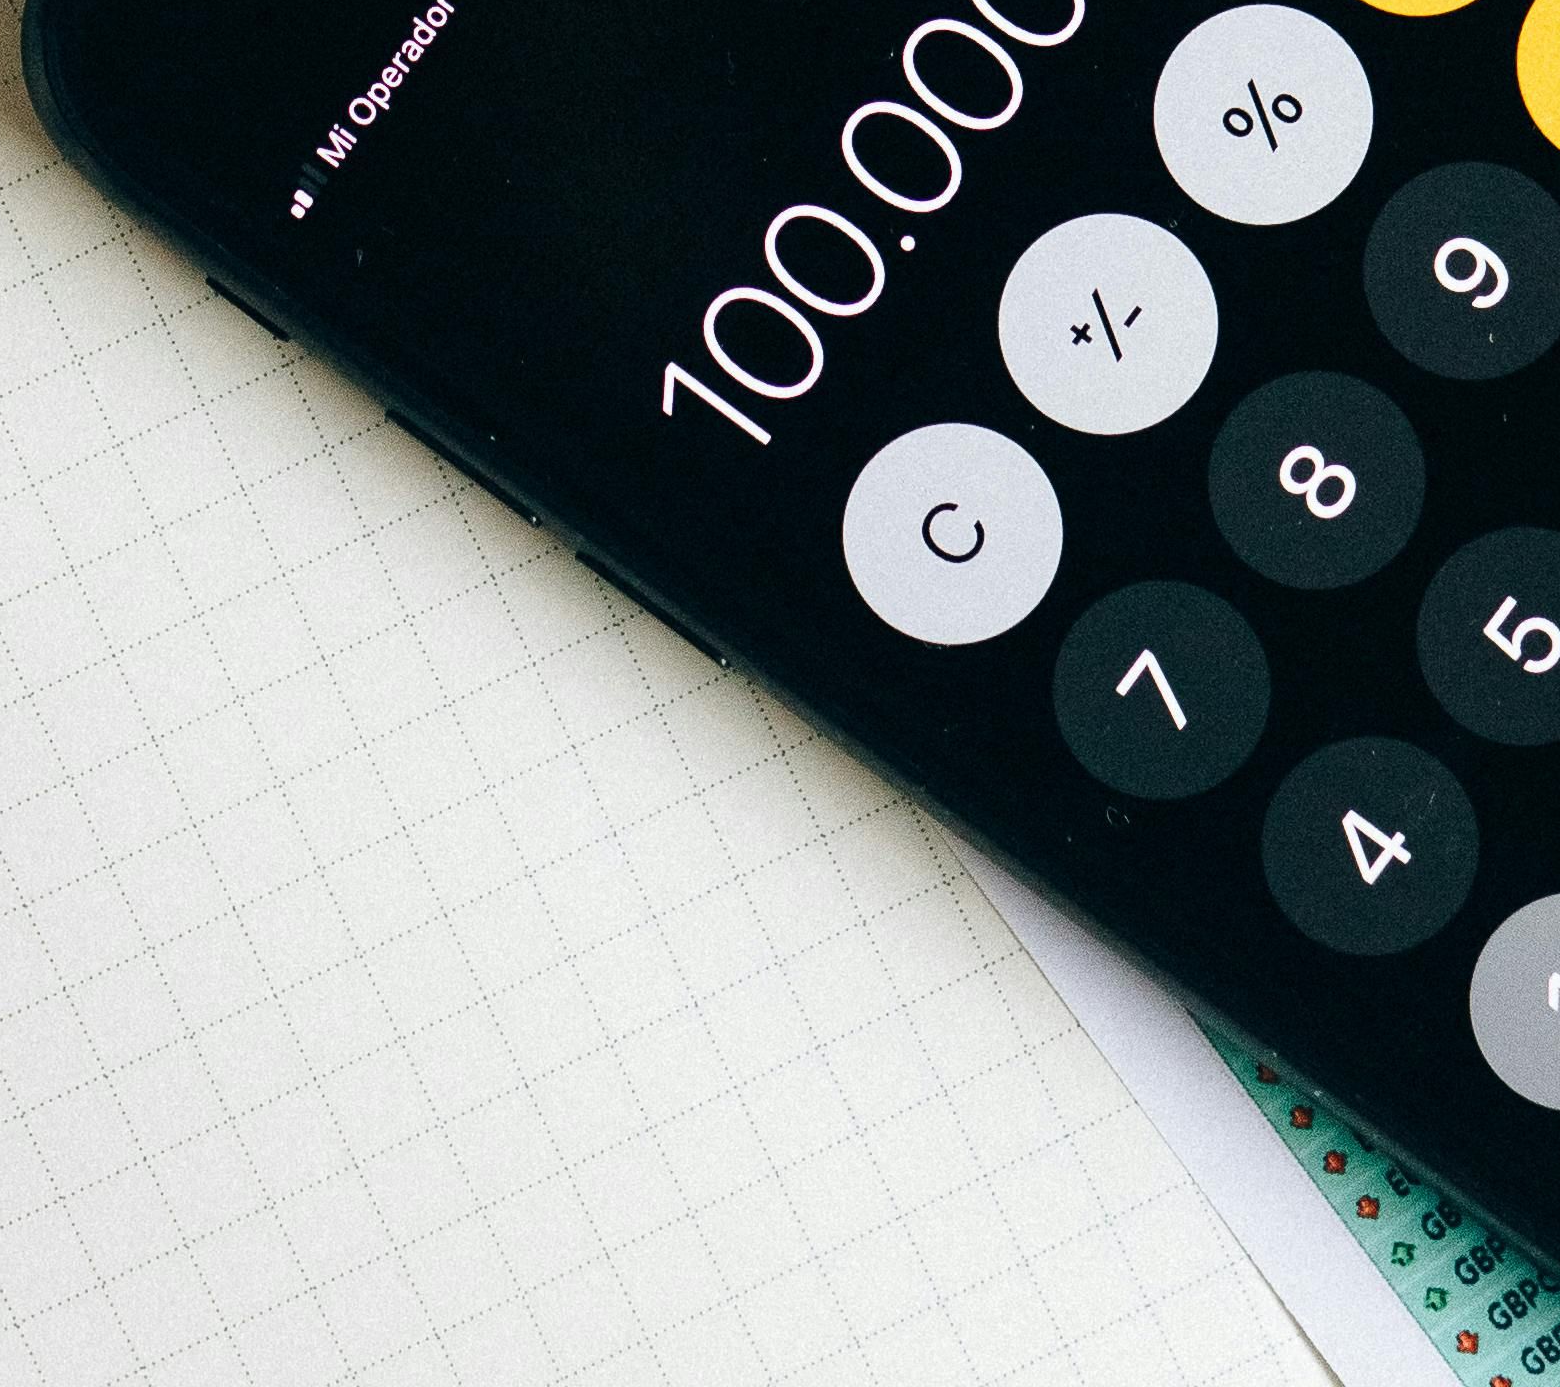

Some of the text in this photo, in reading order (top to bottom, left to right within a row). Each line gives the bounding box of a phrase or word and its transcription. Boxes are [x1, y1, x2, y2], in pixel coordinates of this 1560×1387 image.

[316, 122, 358, 170] Mi
[1223, 79, 1302, 152] %
[1434, 238, 1509, 308] 9
[1280, 446, 1356, 518] 8
[922, 503, 984, 563] C
[1116, 649, 1187, 730] 7
[1342, 810, 1411, 884] 4
